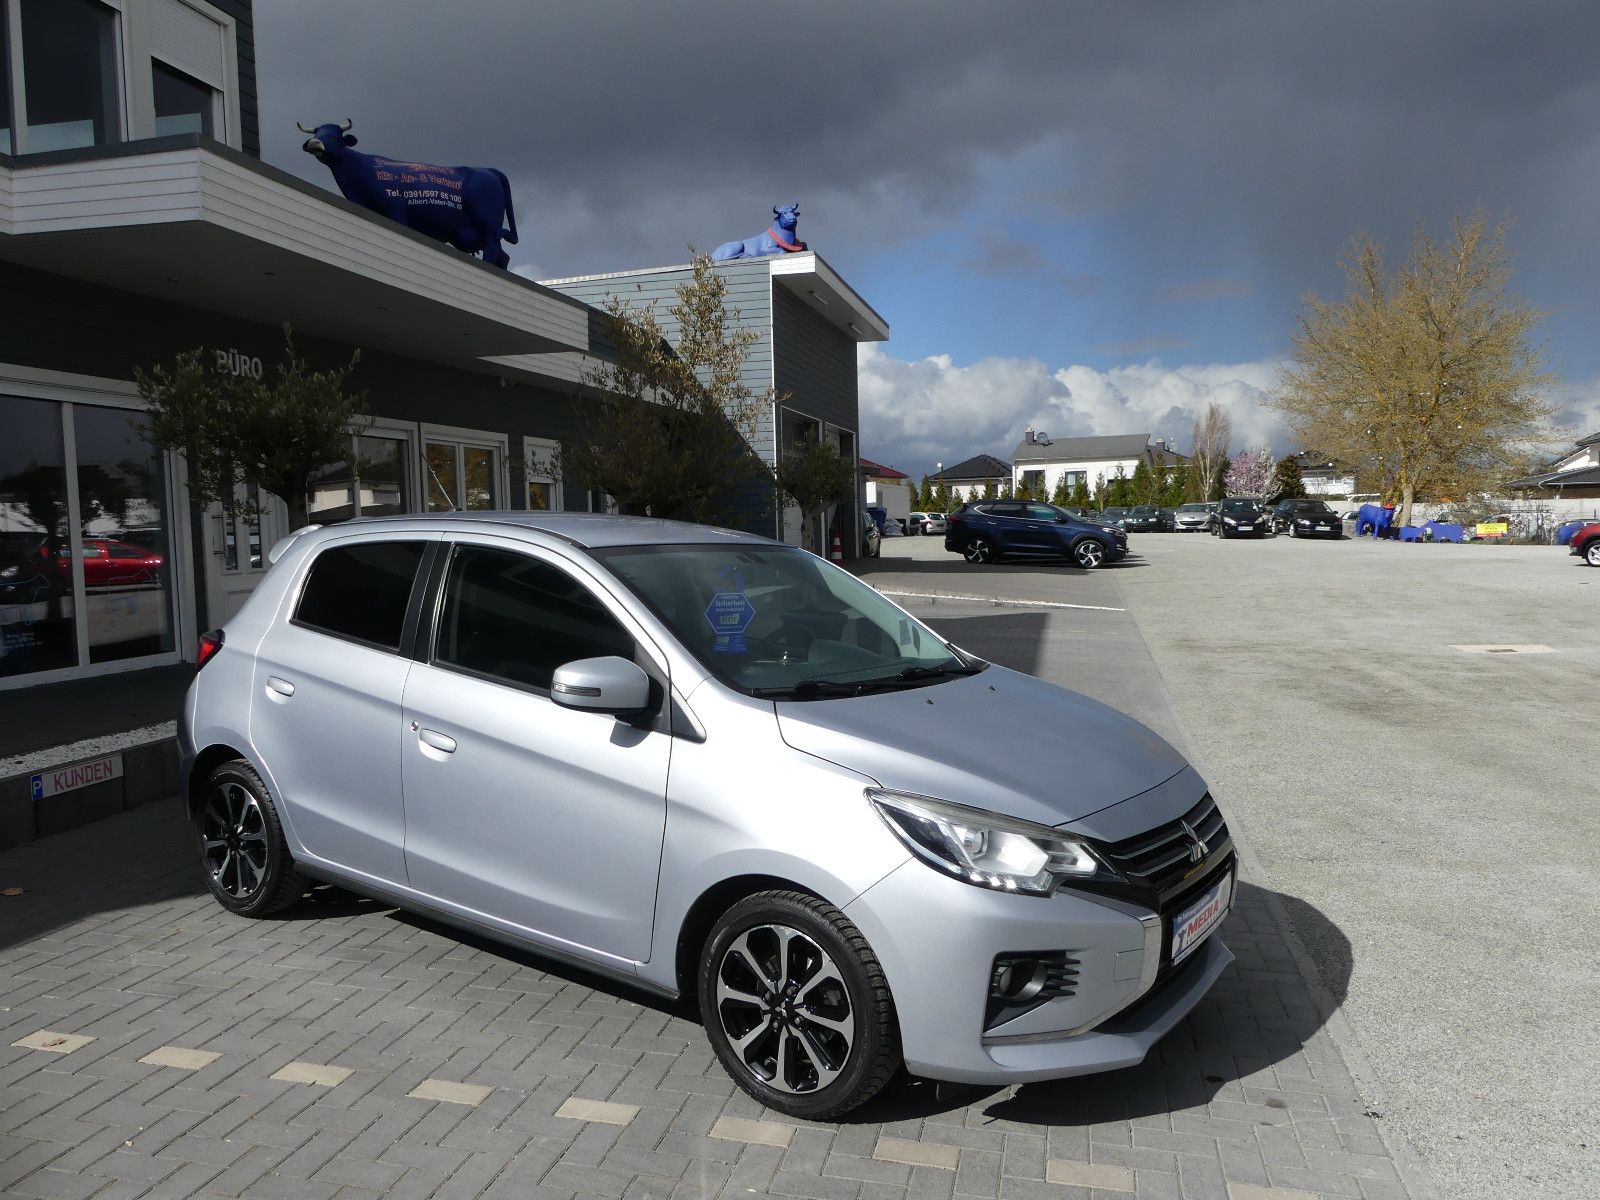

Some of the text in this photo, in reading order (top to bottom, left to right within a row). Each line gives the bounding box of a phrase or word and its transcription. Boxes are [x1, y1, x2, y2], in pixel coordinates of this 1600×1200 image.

[385, 189, 401, 197] Tel.
[403, 190, 438, 199] 0391/597
[450, 194, 462, 203] 100
[216, 347, 263, 381] BÜRO
[33, 760, 113, 796] P KUNDEN
[1187, 899, 1219, 937] MEDIA
